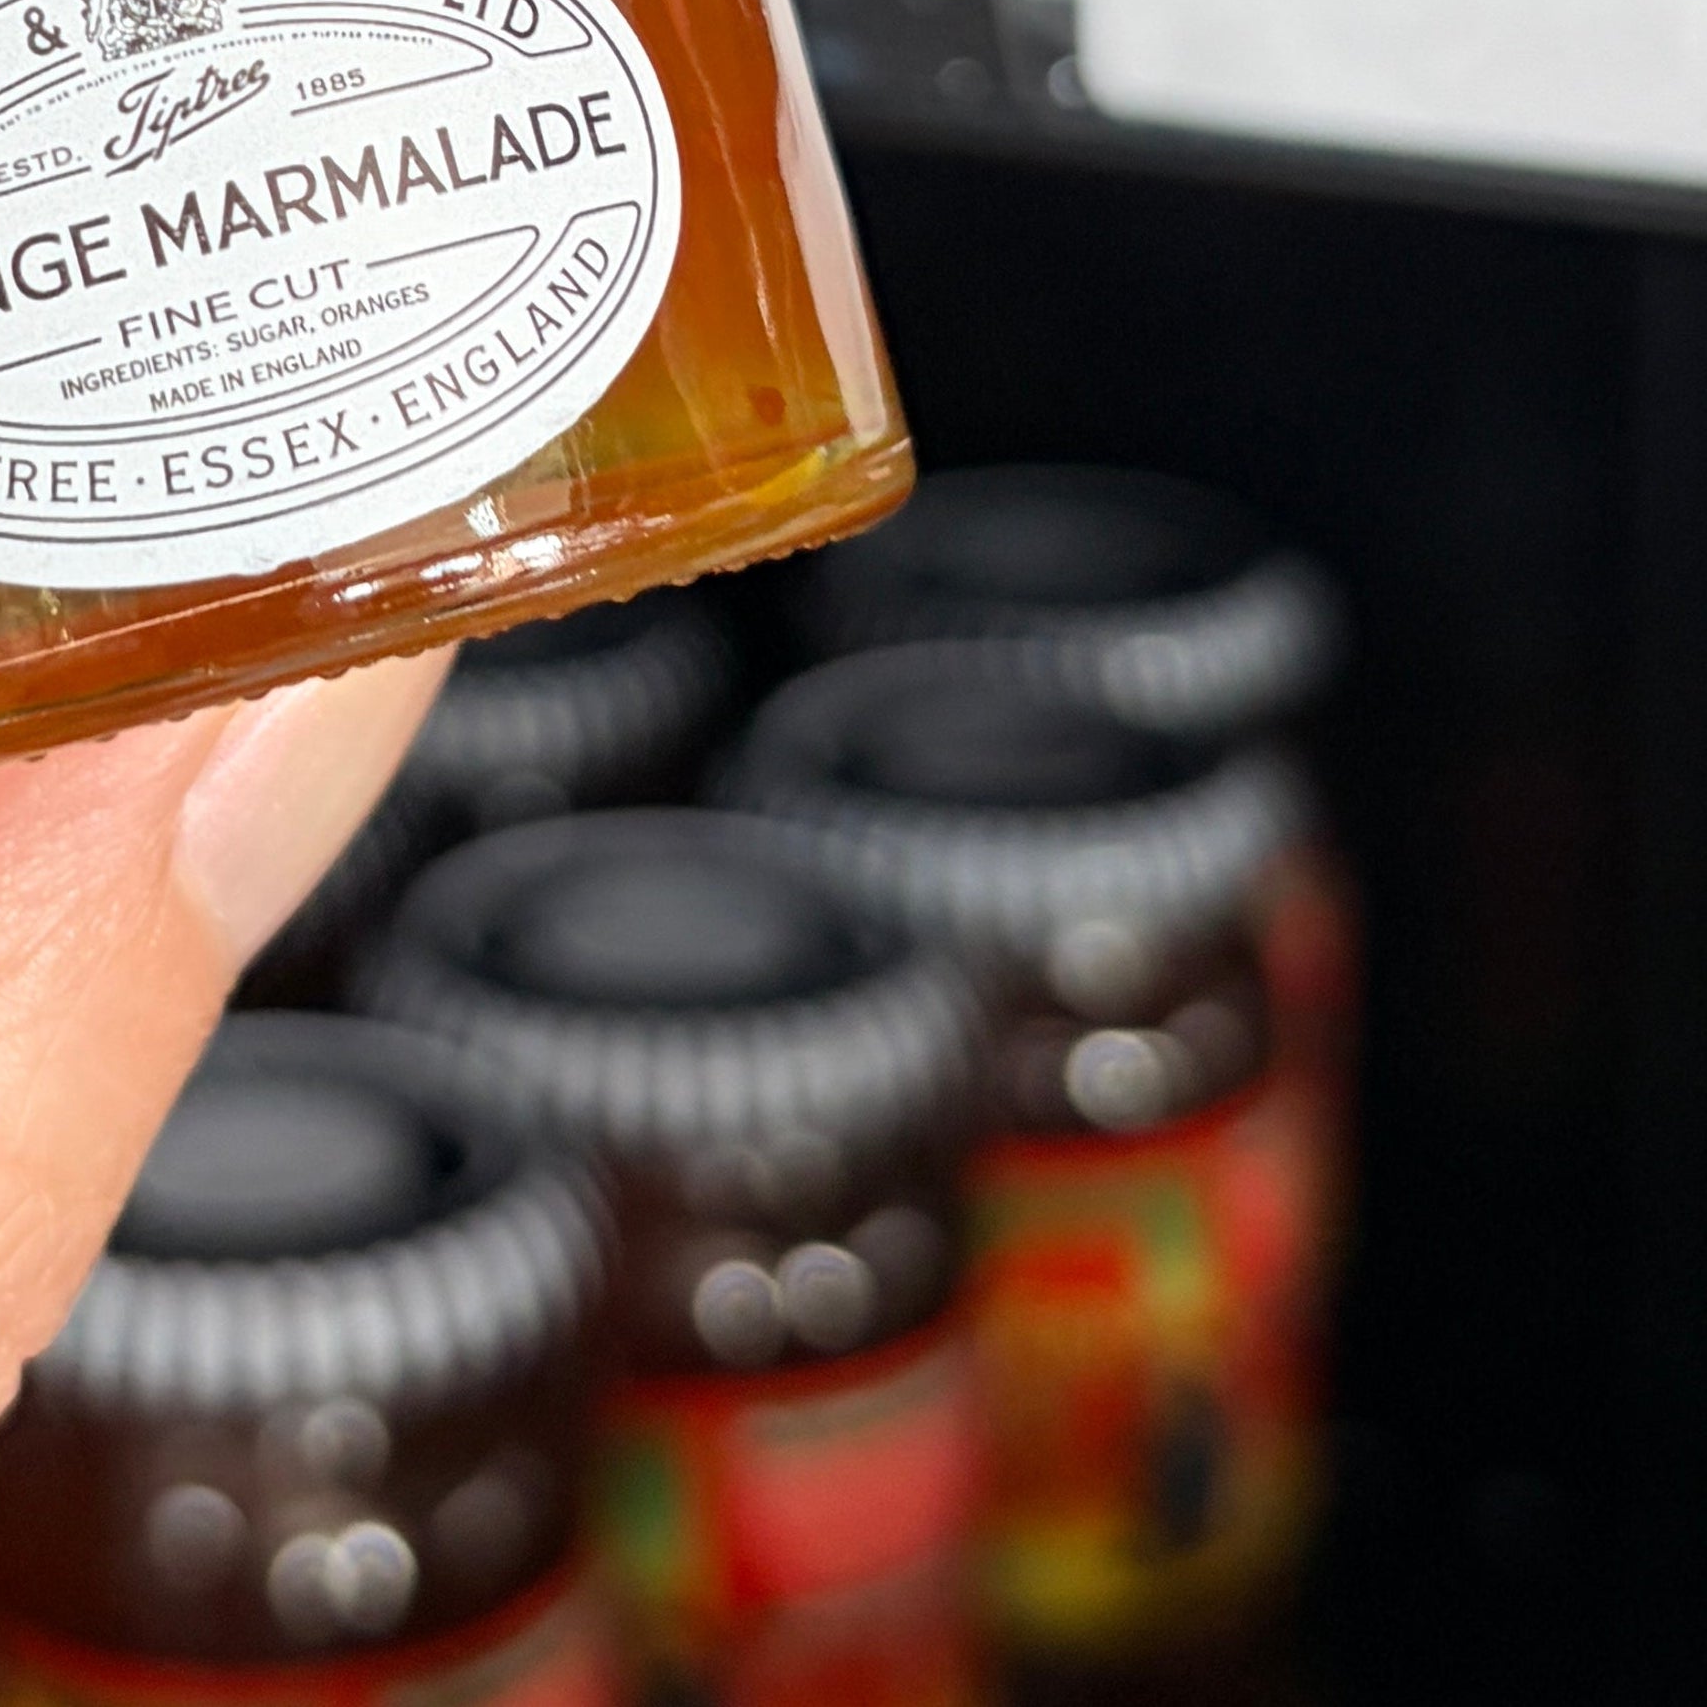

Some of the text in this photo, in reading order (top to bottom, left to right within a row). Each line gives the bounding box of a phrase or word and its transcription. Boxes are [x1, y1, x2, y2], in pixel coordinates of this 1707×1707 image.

[23, 5, 69, 57] &
[103, 58, 271, 178] Tiptree
[295, 69, 366, 102] 1885
[140, 90, 627, 268] MARMALADE
[59, 283, 431, 400] INGREDIENTS: SUGAR, ORANGES
[118, 258, 351, 349] FINE CUT
[149, 338, 363, 413] MADE IN ENGLAND
[161, 409, 361, 497] ESSEX
[392, 236, 610, 428] ENGLAND
